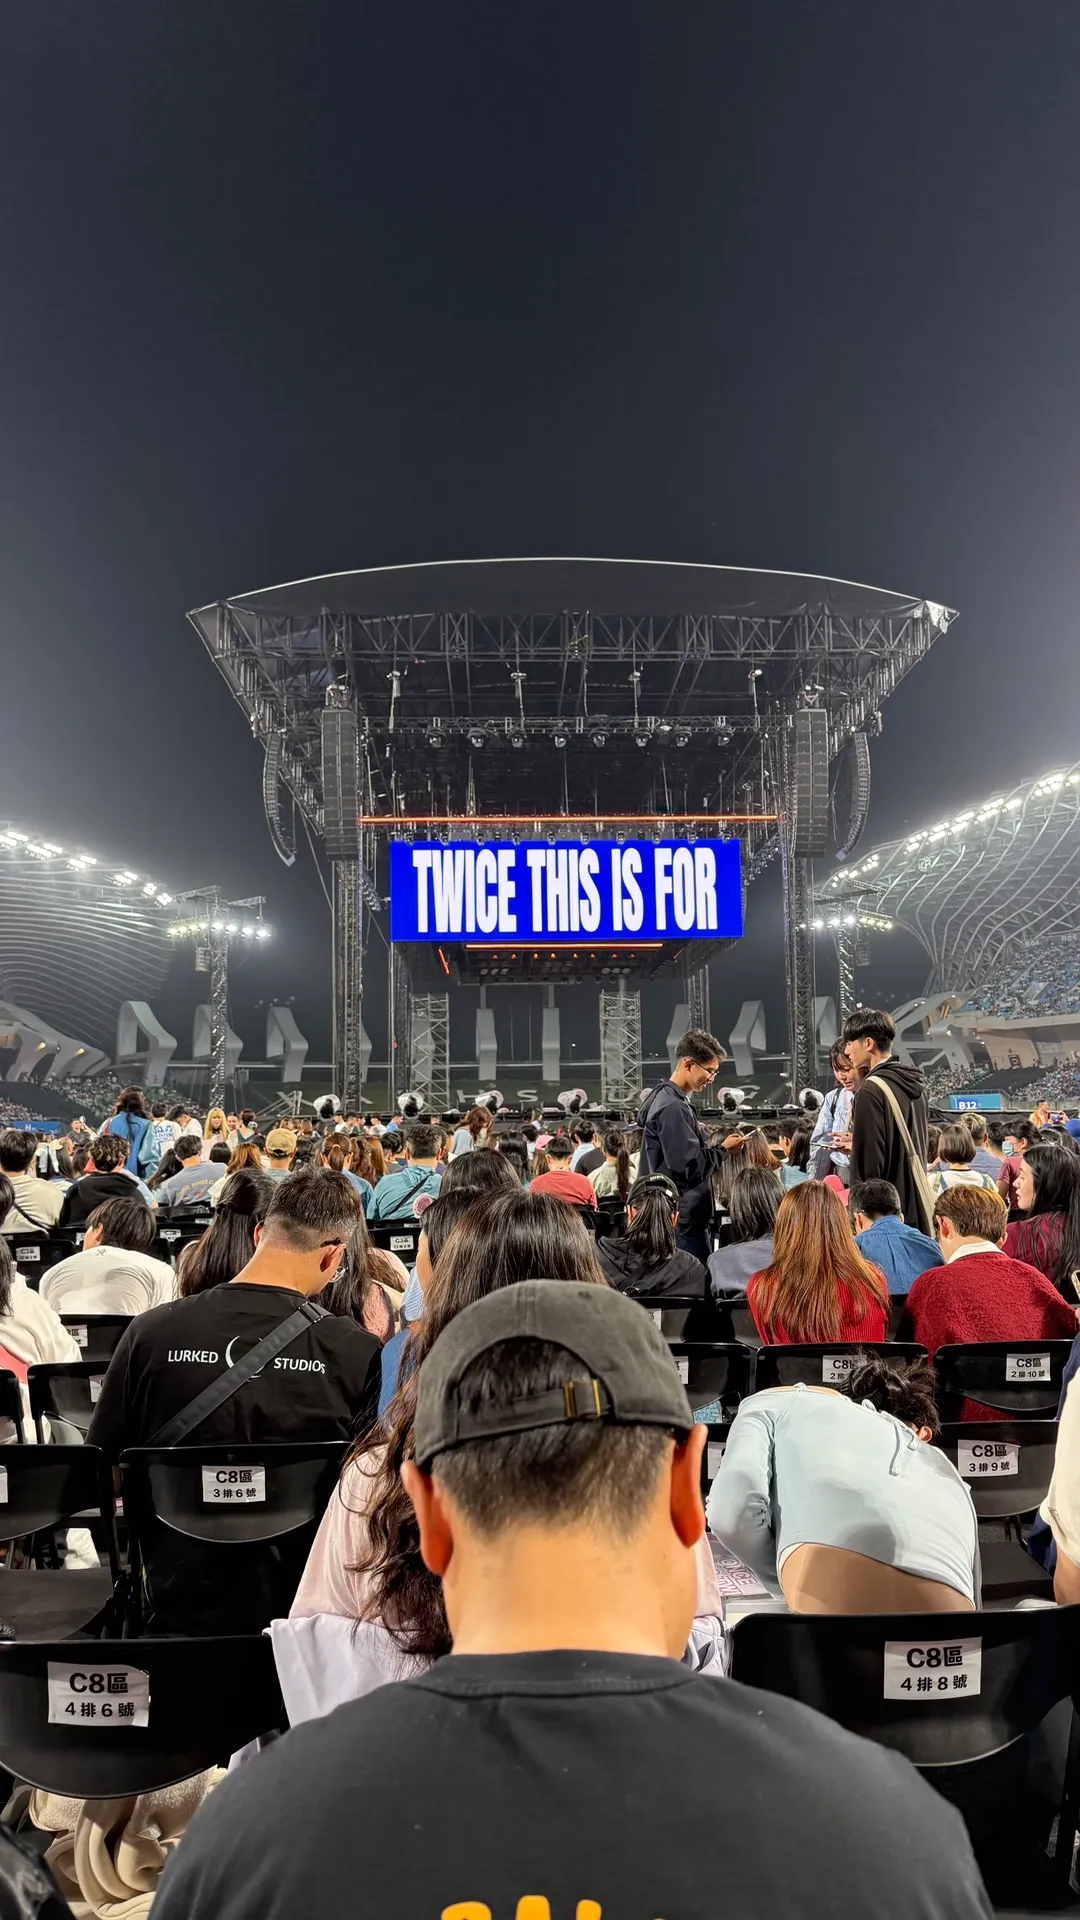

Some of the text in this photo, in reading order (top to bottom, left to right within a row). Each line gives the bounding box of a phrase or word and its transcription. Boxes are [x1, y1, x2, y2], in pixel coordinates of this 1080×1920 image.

[413, 847, 718, 933] TWICE THIS IS FOR
[958, 1101, 977, 1110] B12
[168, 1350, 326, 1374] LURKED STUDIOS
[1016, 1358, 1042, 1367] C8區
[971, 1445, 1007, 1457] C8區
[216, 1470, 253, 1483] C8區
[907, 1646, 963, 1668] C8區
[70, 1672, 129, 1693] C8區
